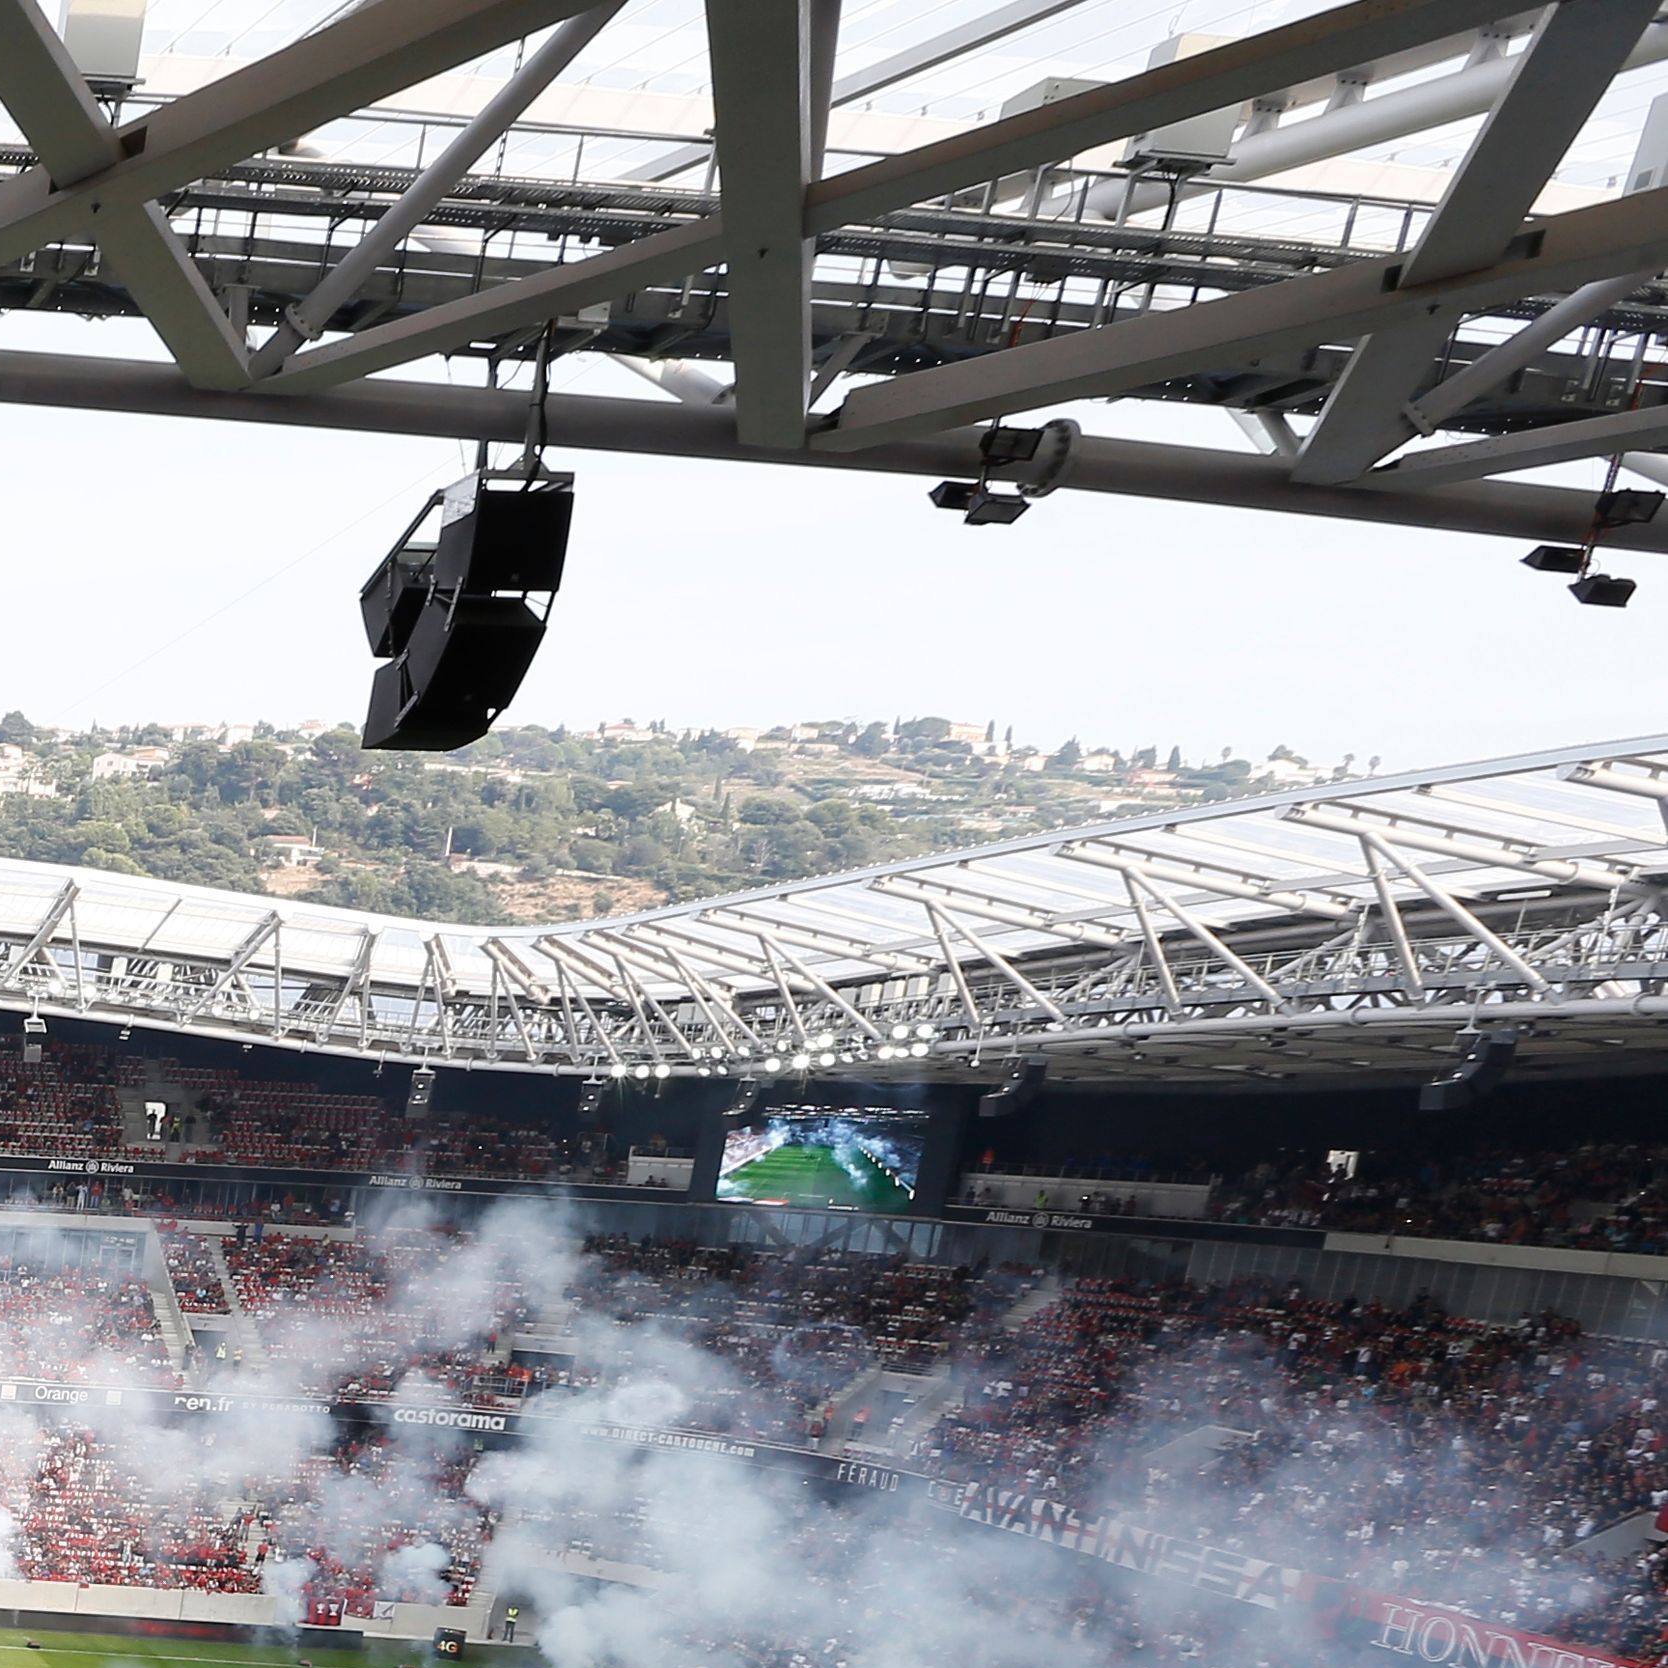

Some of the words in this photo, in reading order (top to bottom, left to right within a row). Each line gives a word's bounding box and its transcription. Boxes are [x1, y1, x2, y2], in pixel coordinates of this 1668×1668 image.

[47, 1158, 84, 1172] Allianz
[99, 1161, 135, 1175] Riviera
[368, 1174, 407, 1187] Allianz
[424, 1178, 462, 1191] Riviera
[984, 1210, 1031, 1225] Allianz
[1050, 1214, 1093, 1229] Riviera
[34, 1385, 89, 1403] Orange
[393, 1405, 507, 1432] castorama
[836, 1463, 899, 1493] FÉRAUD
[438, 1640, 459, 1654] 4G
